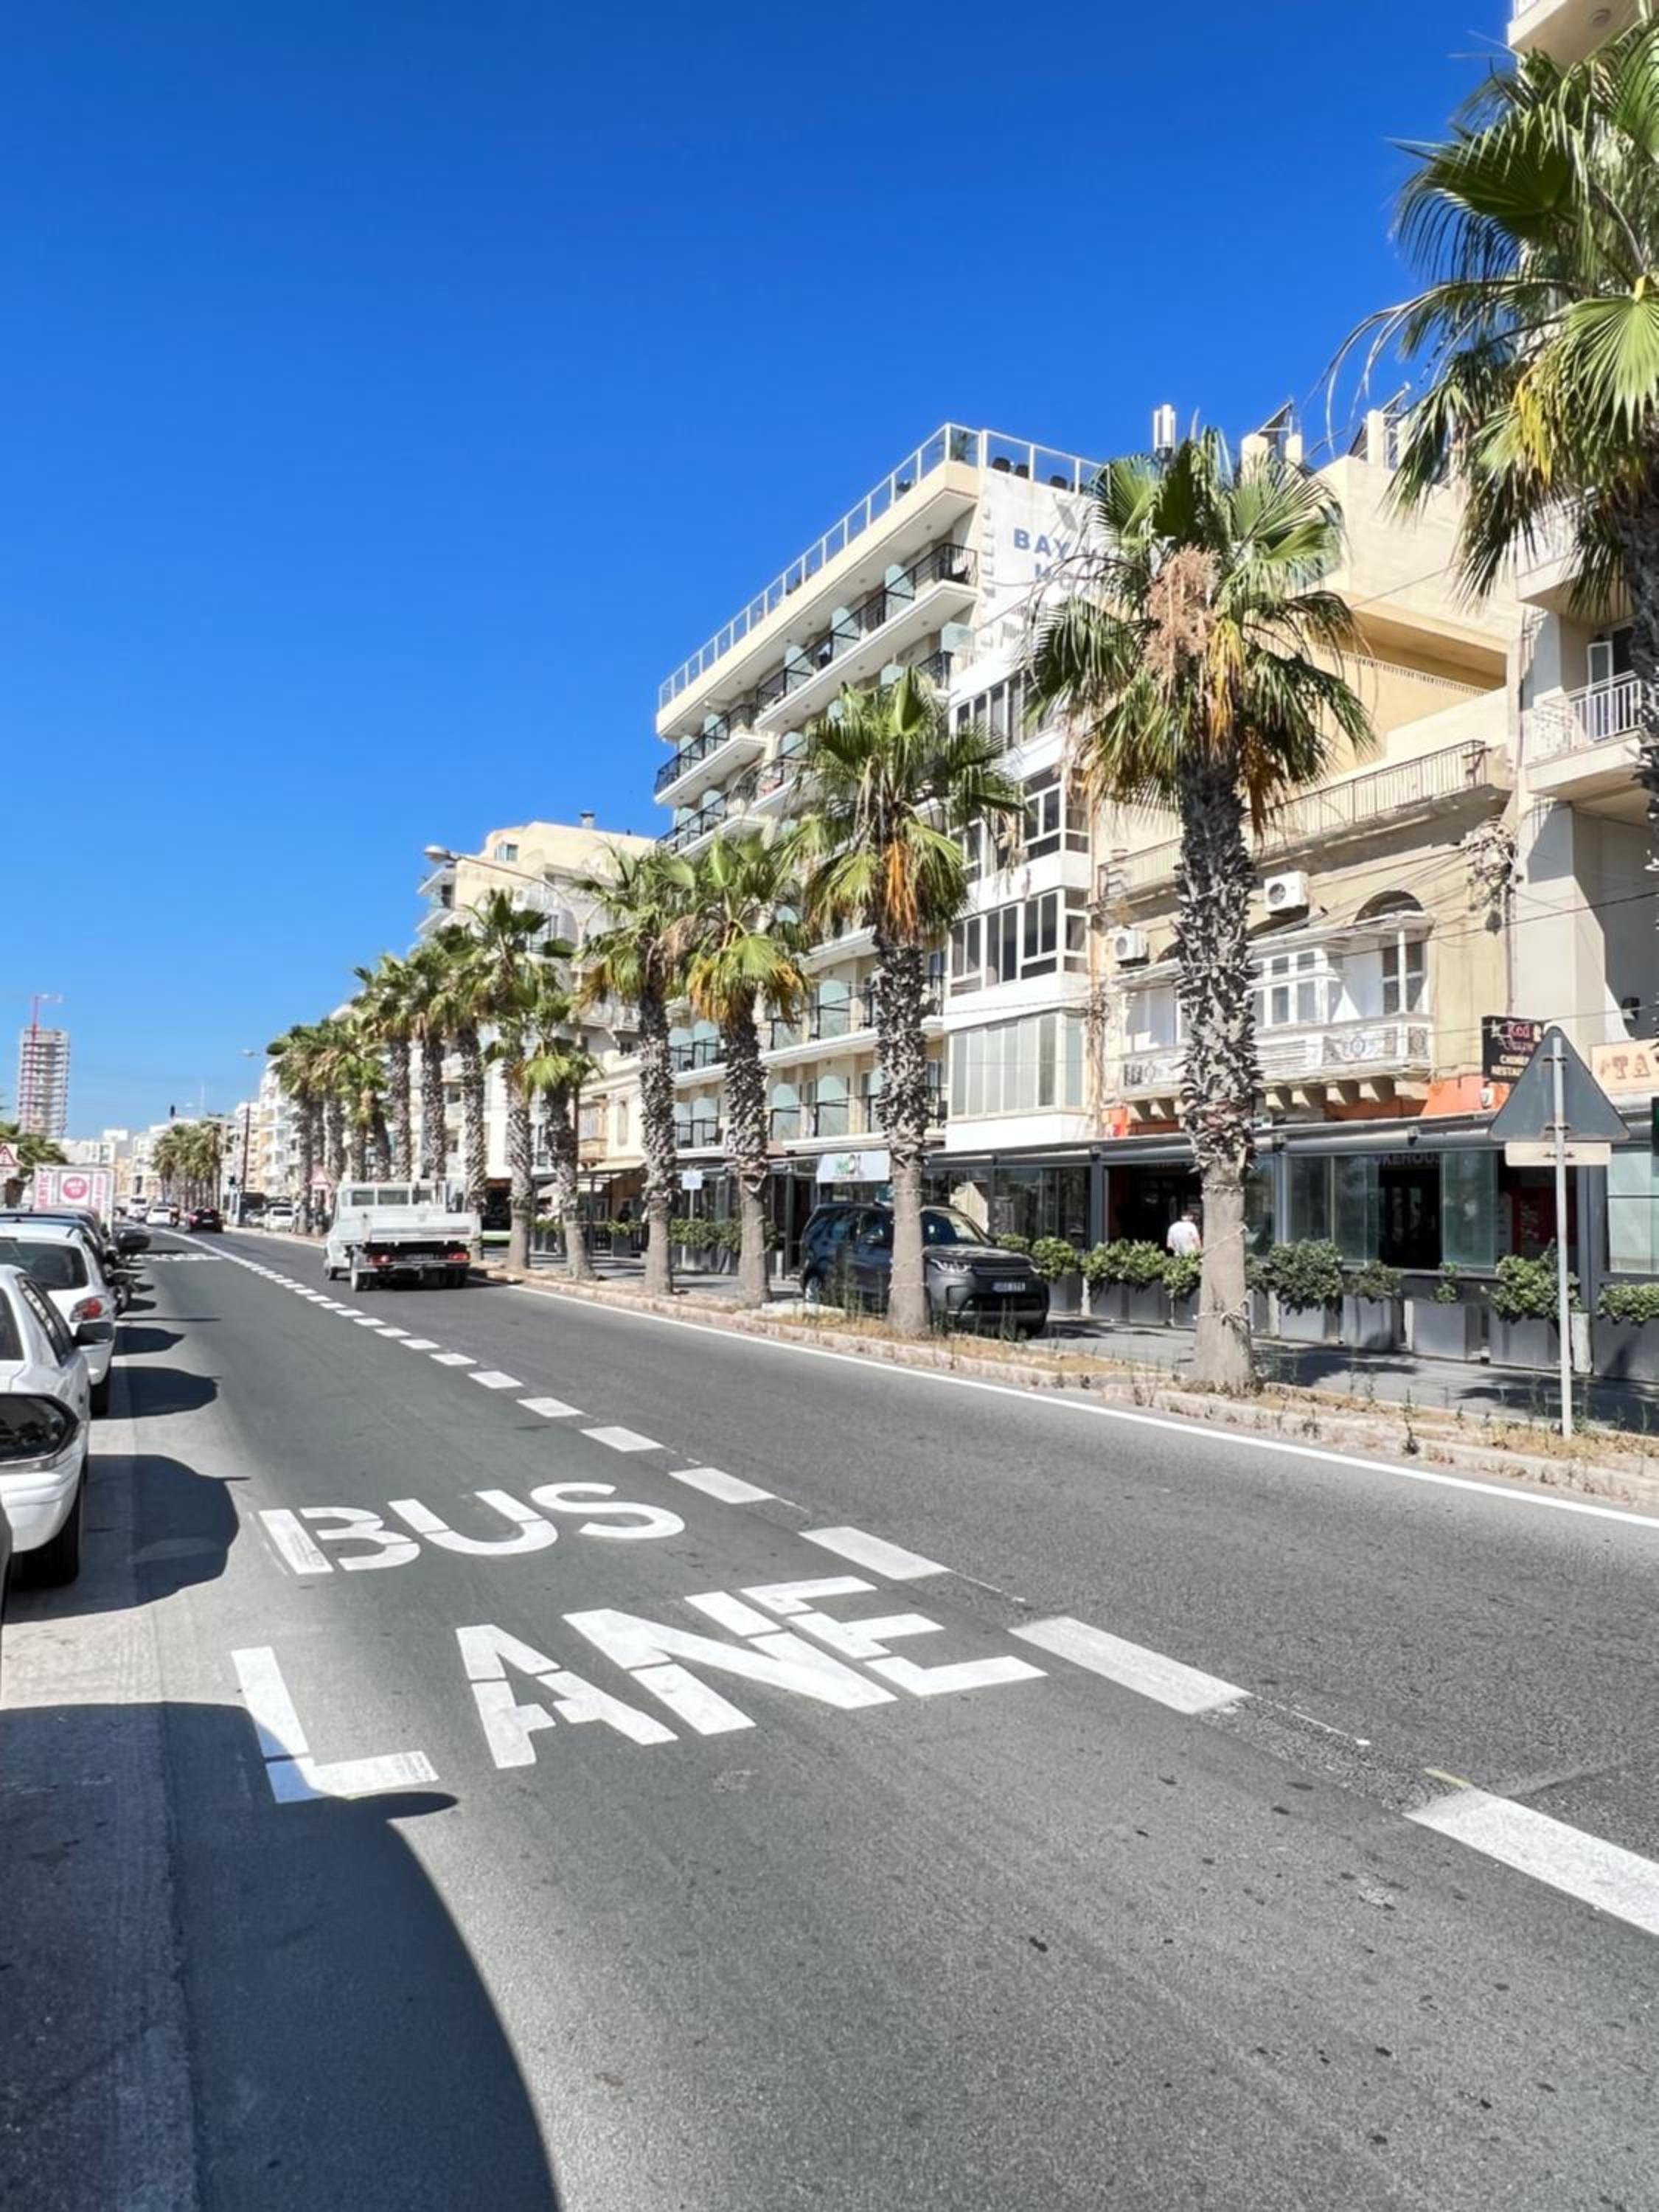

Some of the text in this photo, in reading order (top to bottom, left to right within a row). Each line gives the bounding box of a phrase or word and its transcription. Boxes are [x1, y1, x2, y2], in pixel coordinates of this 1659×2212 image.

[1013, 527, 1071, 560] BAY
[258, 1482, 685, 1574] BUS
[231, 1575, 1048, 1804] LANE
